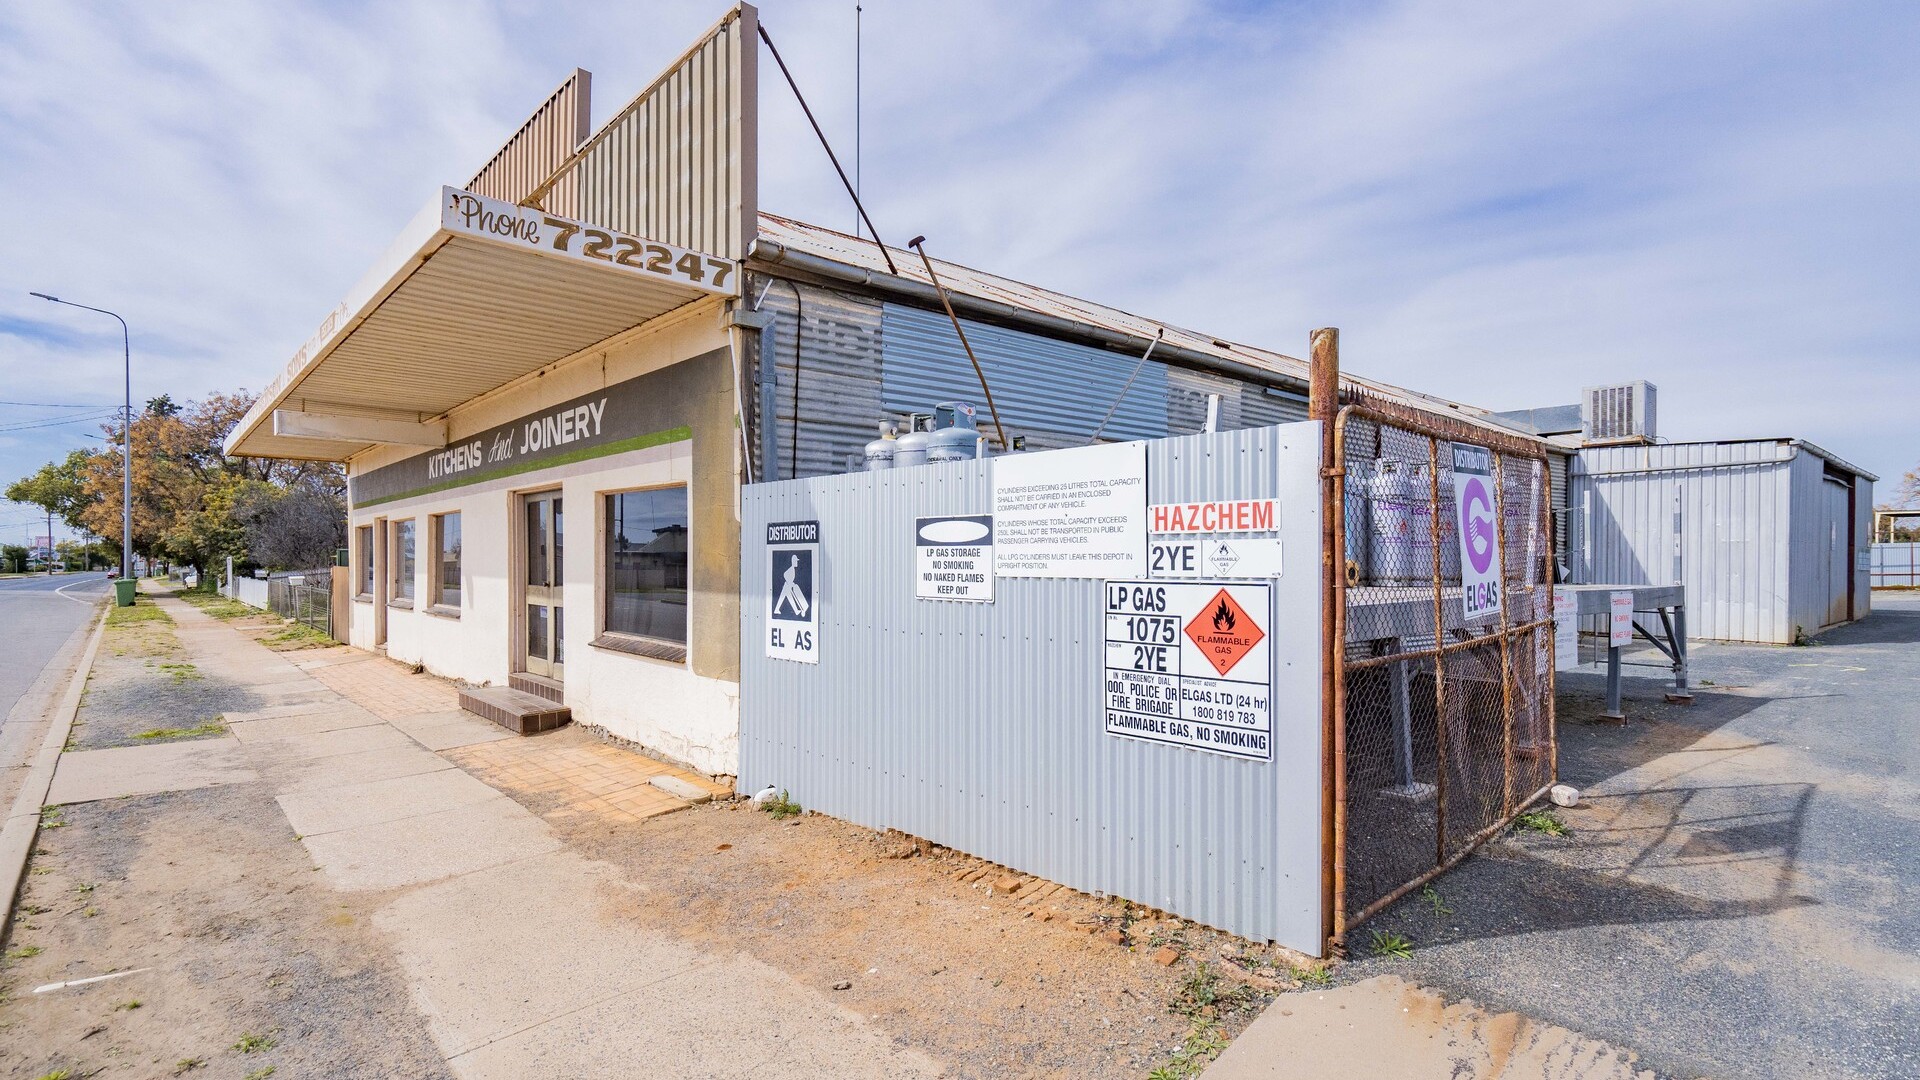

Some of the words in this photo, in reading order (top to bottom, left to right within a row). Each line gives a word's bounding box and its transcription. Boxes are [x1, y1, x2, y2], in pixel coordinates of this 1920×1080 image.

[460, 195, 540, 244] Phone
[543, 216, 733, 288] 722247
[428, 440, 482, 480] KITCHENS
[488, 428, 514, 463] And
[520, 398, 608, 454] JOINERY
[1454, 448, 1489, 471] DISTRIBUTOR
[1028, 484, 1059, 492] EXCEEDING
[1109, 478, 1141, 486] CAPACITY
[1036, 492, 1060, 501] CARRIED
[1078, 490, 1111, 498] ENCLOSED
[997, 503, 1038, 512] COMPARTMENT
[1154, 501, 1273, 532] HAZCHEM
[768, 524, 816, 541] DISTRIBUTOR
[927, 548, 934, 557] LP
[936, 548, 948, 557] GAS
[951, 548, 980, 557] STORAGE
[1152, 546, 1194, 571] 2YE
[932, 561, 941, 569] NO
[944, 561, 974, 569] SMOKING
[924, 573, 932, 581] NO
[934, 573, 955, 582] NAKED
[957, 574, 984, 582] FLAMES
[938, 585, 954, 594] KEEP
[956, 586, 968, 594] OUT
[1109, 586, 1128, 610] LP
[1132, 587, 1166, 612] GAS
[1466, 580, 1498, 613] ELGAS
[1126, 617, 1175, 643] 1075
[1197, 636, 1250, 647] FLAMMABLE
[1134, 646, 1167, 672] 2YE
[1122, 673, 1155, 684] EMERGENCY
[1158, 676, 1171, 686] DIAL
[1130, 684, 1160, 699] POLICE
[1165, 687, 1177, 701] OR
[1182, 689, 1212, 703] ELGAS
[1214, 692, 1233, 706] LTD
[1236, 694, 1251, 709] (24
[1254, 697, 1268, 712] hr)
[1112, 695, 1130, 709] FIRE
[1136, 699, 1173, 715] BRIGADE
[1192, 706, 1214, 720] 1800
[1217, 708, 1234, 722] 819
[1238, 711, 1256, 725] 783
[1108, 713, 1166, 734] FLAMMABLE
[1169, 722, 1192, 740] GAS,
[1197, 726, 1210, 741] NO
[1213, 729, 1266, 750] SMOKING
